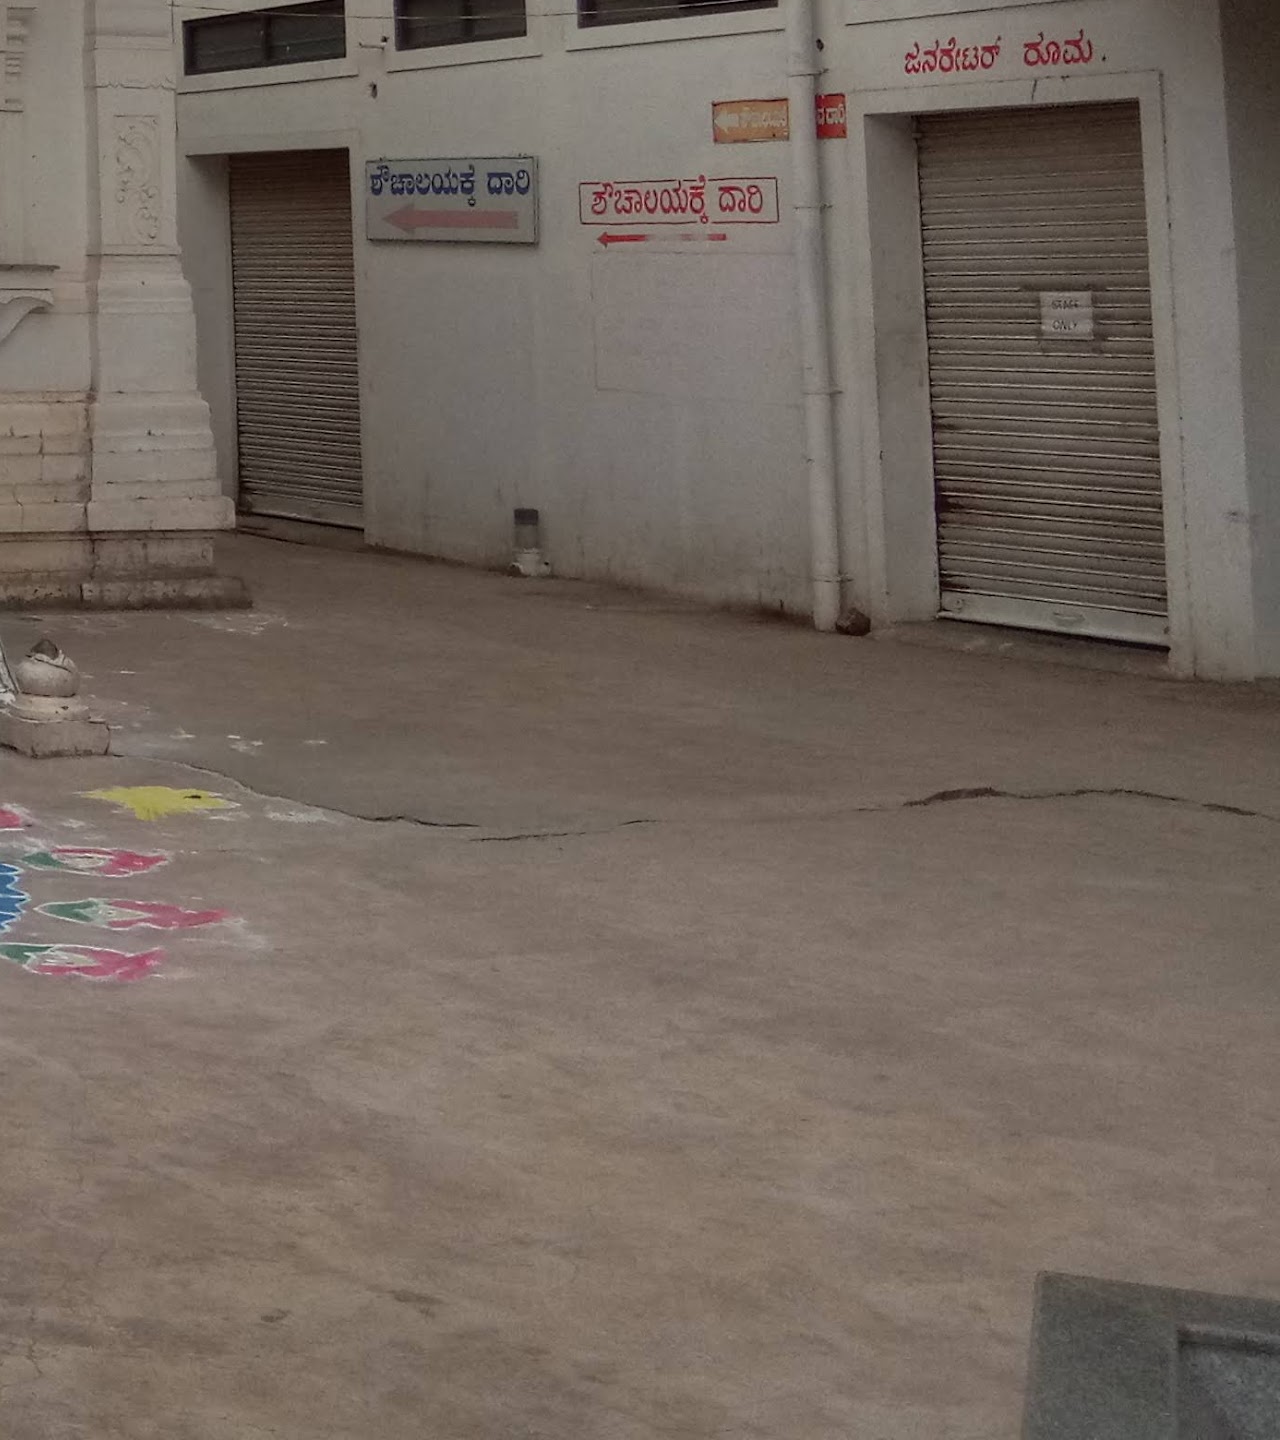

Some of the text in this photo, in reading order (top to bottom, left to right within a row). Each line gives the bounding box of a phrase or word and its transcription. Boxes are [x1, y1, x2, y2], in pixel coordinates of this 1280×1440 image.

[370, 164, 531, 207] ಶೌಚಾಲಯಕ್ಕೆ ದಾರಿ
[591, 174, 763, 224] ಶೌಚಾಲಯಕ್ಕೆ ದಾರಿ
